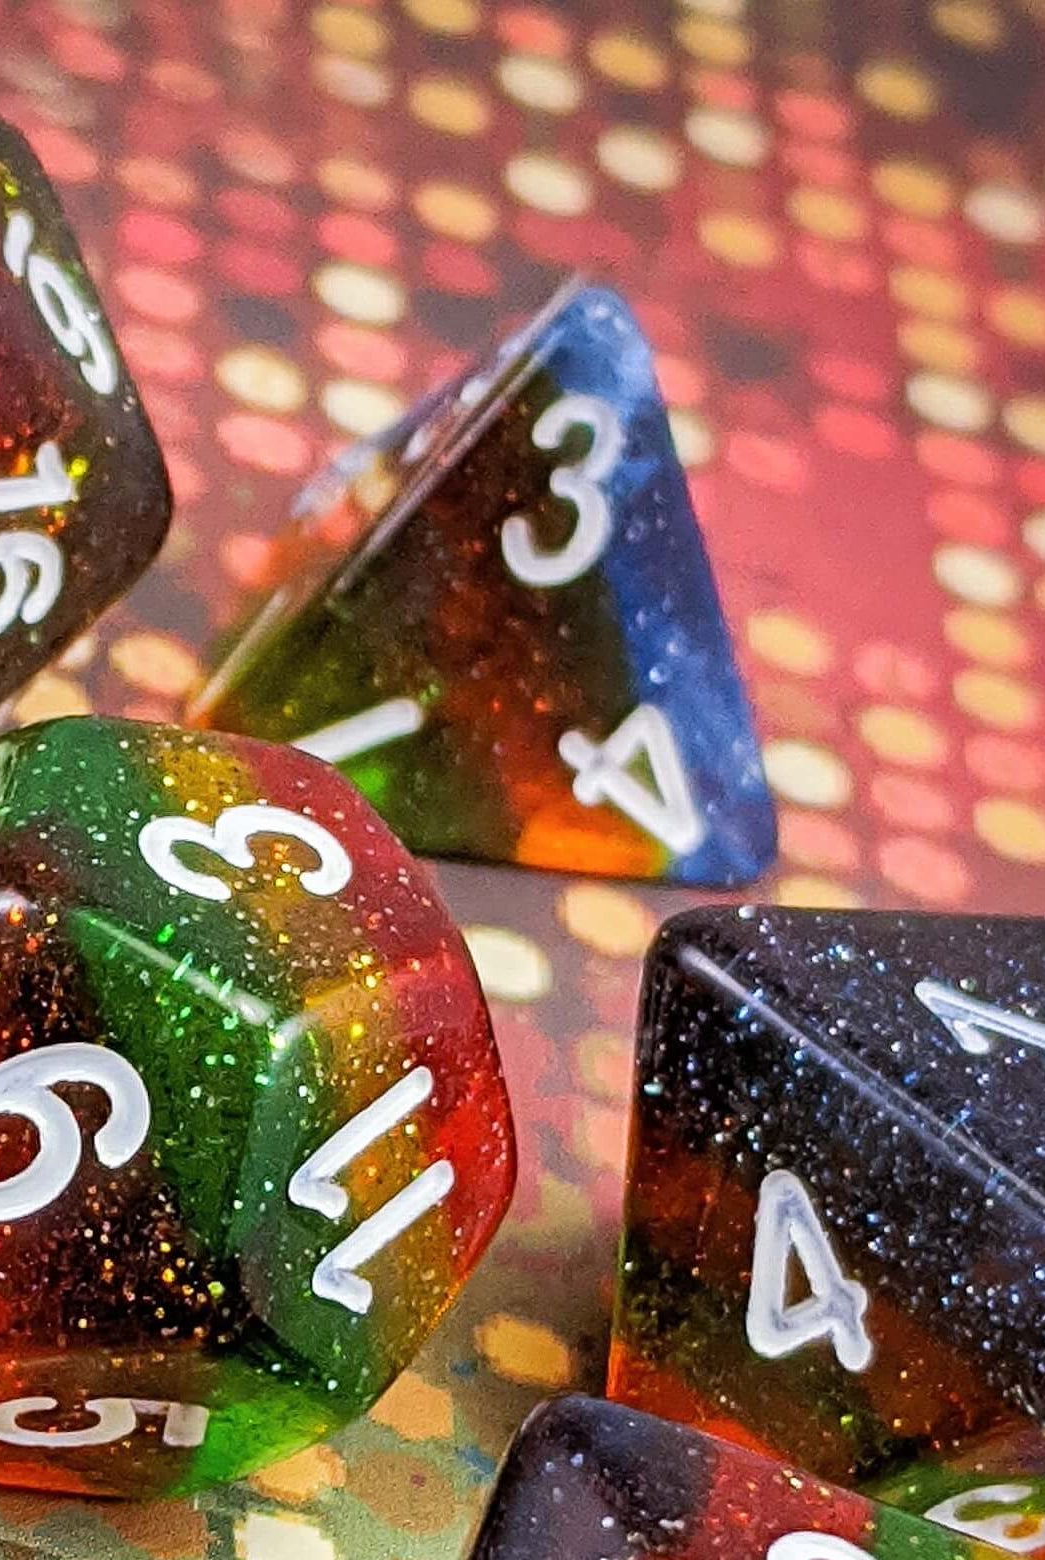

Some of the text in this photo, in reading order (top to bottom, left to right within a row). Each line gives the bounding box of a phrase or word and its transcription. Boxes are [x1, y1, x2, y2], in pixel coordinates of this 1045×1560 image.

[501, 393, 621, 588] 3
[138, 804, 353, 901] 3
[558, 703, 705, 854] 4
[289, 1066, 455, 1314] 11
[746, 1170, 872, 1372] 4
